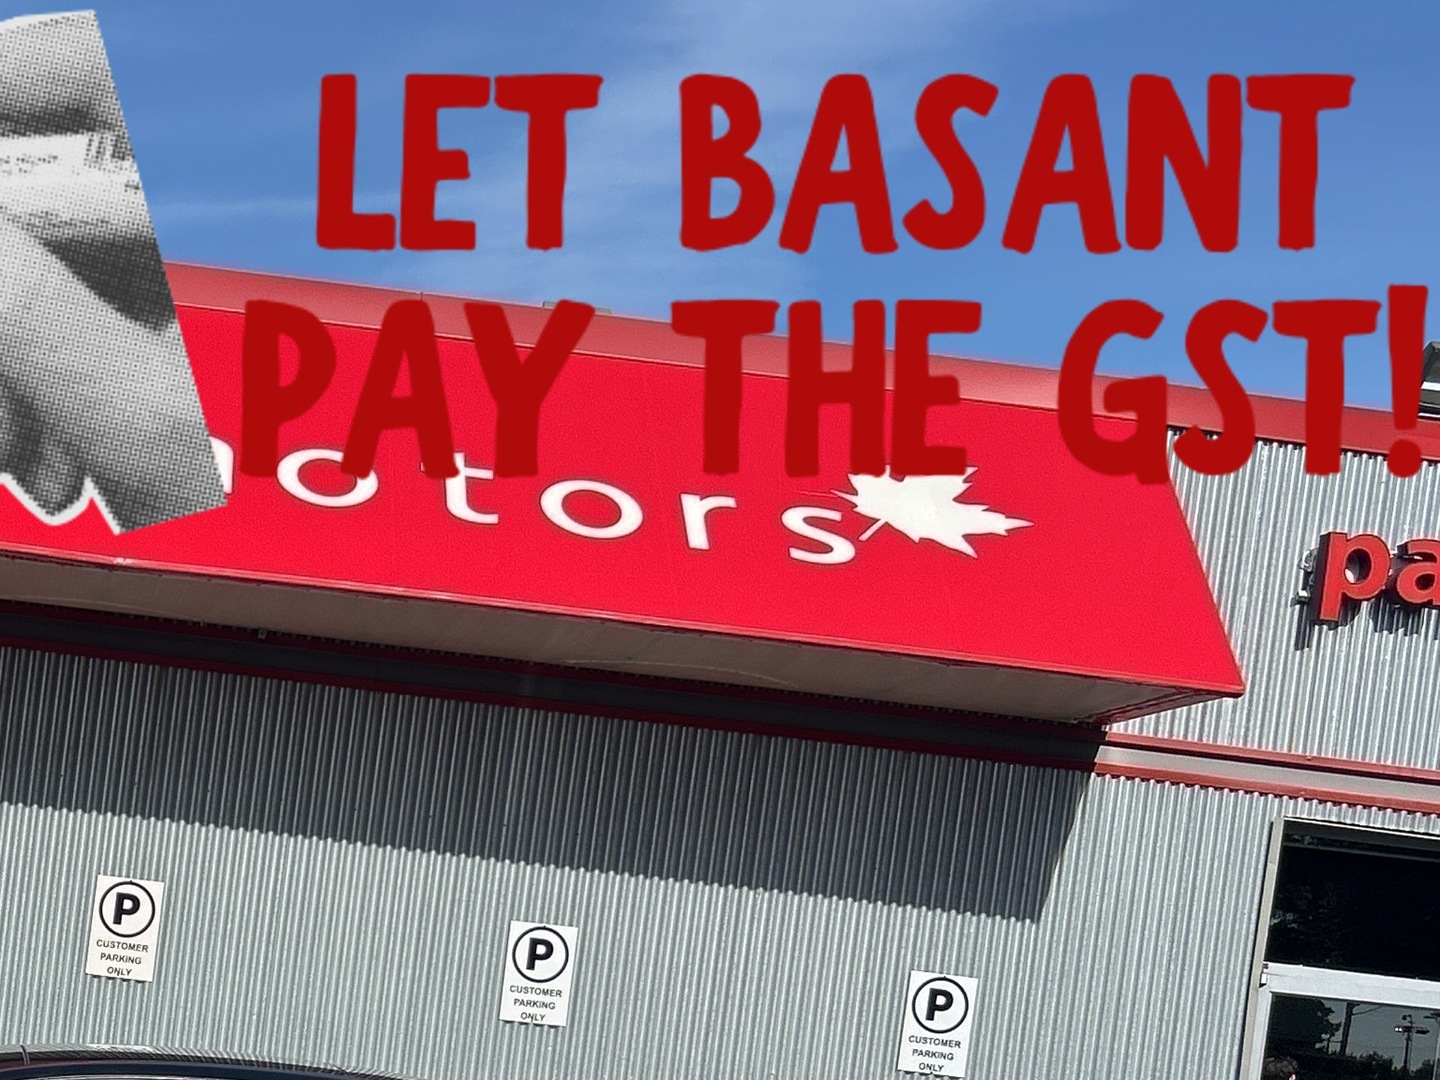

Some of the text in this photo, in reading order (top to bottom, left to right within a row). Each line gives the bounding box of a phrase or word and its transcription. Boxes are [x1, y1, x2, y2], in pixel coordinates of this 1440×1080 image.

[210, 434, 858, 568] otors
[113, 891, 141, 926] P
[96, 939, 149, 953] CUSTOMER
[100, 952, 142, 965] PARKING
[526, 937, 554, 971] P
[106, 966, 133, 976] ONLY
[509, 984, 563, 998] CUSTOMER
[513, 998, 556, 1010] PARKING
[925, 987, 954, 1021] P
[520, 1011, 547, 1022] ONLY
[908, 1035, 961, 1049] CUSTOMER
[912, 1048, 954, 1061] PARKING
[918, 1062, 945, 1072] ONLY
